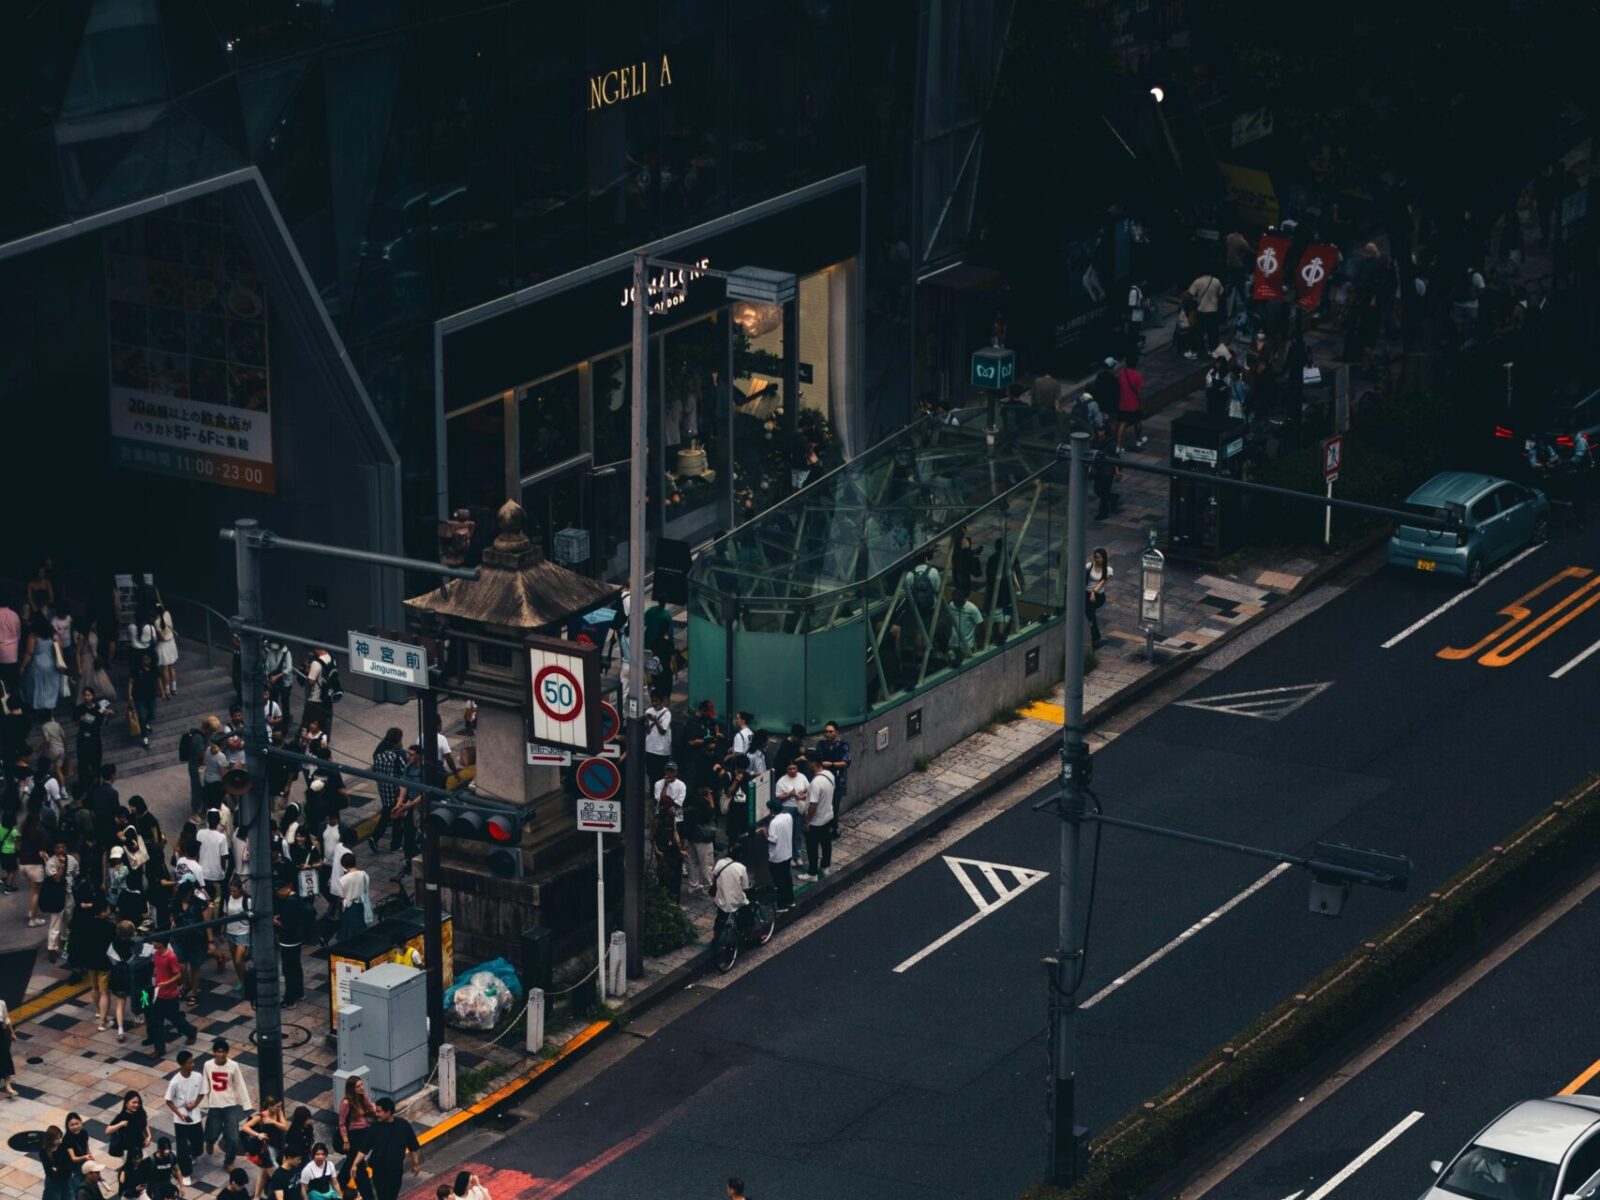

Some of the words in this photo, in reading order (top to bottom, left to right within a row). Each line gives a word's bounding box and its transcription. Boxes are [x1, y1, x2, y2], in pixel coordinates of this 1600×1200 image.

[355, 639, 420, 670] 神宮前
[370, 662, 407, 678] Jingumae
[544, 680, 573, 707] 50
[211, 1071, 229, 1091] 5
